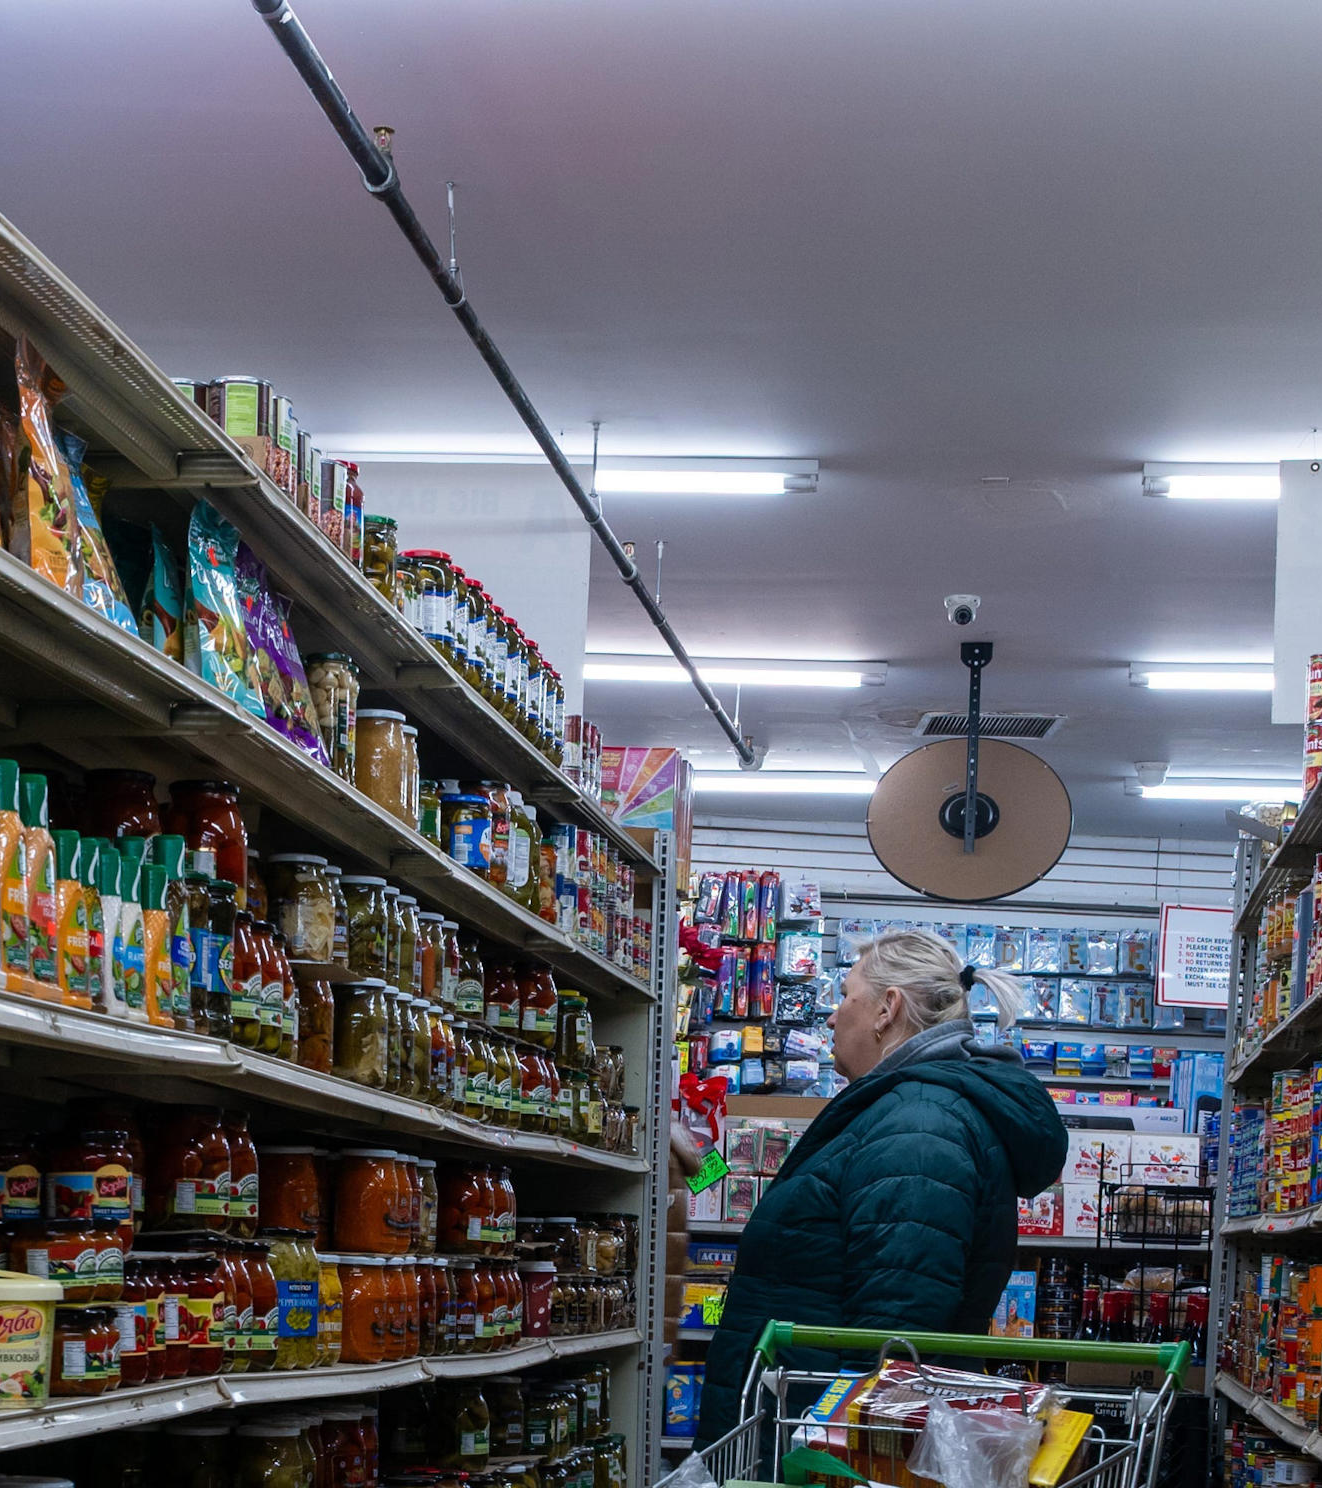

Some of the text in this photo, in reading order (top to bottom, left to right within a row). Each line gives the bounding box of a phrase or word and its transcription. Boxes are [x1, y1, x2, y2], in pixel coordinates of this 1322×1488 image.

[1069, 944, 1081, 965] E
[1130, 998, 1145, 1016] M
[1104, 1093, 1125, 1101] Pepto
[701, 1253, 717, 1261] ACT
[819, 1379, 853, 1416] LARGE SIZE
